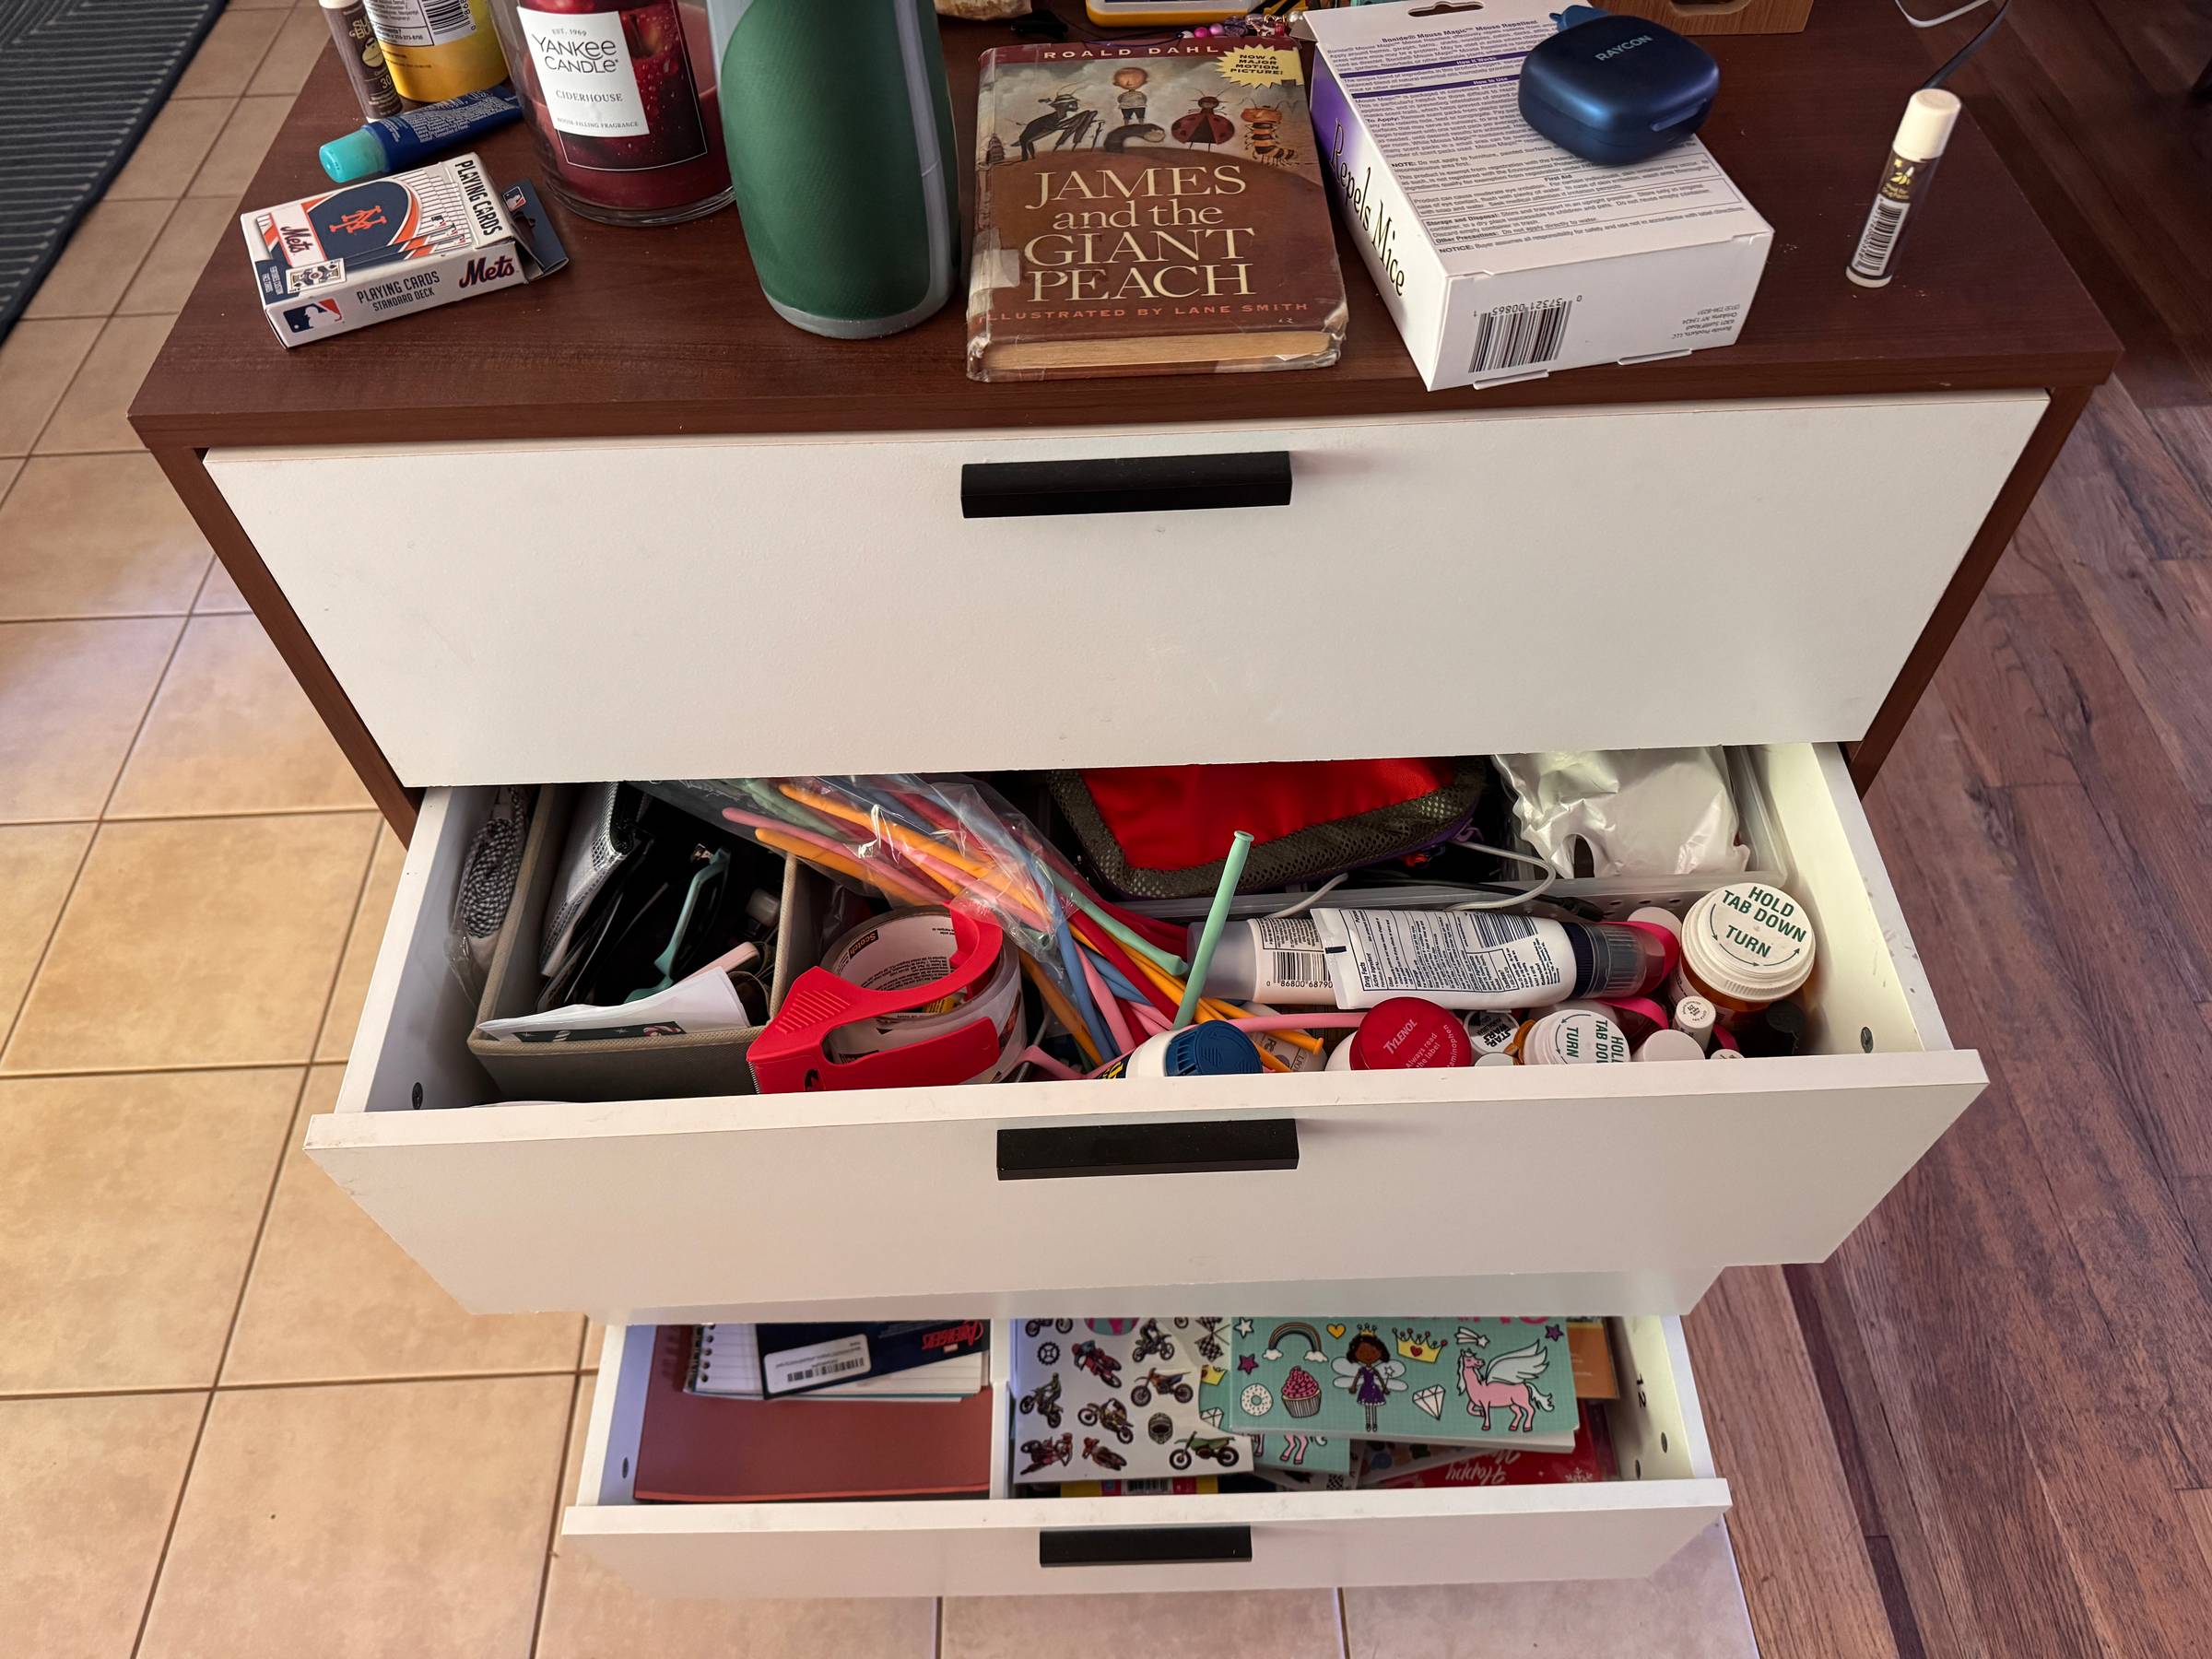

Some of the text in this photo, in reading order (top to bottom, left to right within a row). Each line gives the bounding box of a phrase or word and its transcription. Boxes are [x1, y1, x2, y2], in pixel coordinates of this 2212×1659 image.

[570, 29, 587, 37] 1969
[1043, 44, 1219, 60] ROALD DAHL
[1594, 34, 1653, 63] RAYCON
[381, 75, 392, 88] 30
[1230, 67, 1285, 76] PICTURE!
[556, 89, 623, 103] CIDERHOUSE
[600, 121, 639, 129] FRAGRANCE
[454, 159, 503, 236] PLAYING CARDS
[1025, 165, 1248, 210] JAMES
[1053, 197, 1224, 229] and the
[1331, 118, 1406, 297] Repels Mice
[279, 227, 305, 254] Mets
[1024, 228, 1255, 267] GIANT
[1439, 244, 1475, 253] NOTICE:
[459, 255, 515, 288] Mets
[1027, 263, 1256, 303] PEACH
[357, 270, 441, 304] PLAYING CARDS
[372, 287, 435, 312] STANDARD DECK
[977, 302, 1309, 324] ILLUSTRATED BY LANE SMITH
[1492, 303, 1525, 315] 00865
[1747, 886, 1795, 918] HOLD
[1722, 890, 1807, 943] TAB DOWN
[849, 933, 876, 955] Scotch
[1725, 924, 1772, 959] TURN
[1382, 1018, 1418, 1054] TYLENOL
[1483, 1023, 1509, 1042] WARS
[1484, 1028, 1512, 1047] STAR
[1566, 1027, 1579, 1058] TURN
[1595, 1019, 1608, 1063] TAB DO
[1406, 1032, 1438, 1068] Always read
[1425, 1042, 1441, 1059] label
[1445, 1461, 1508, 1486] Happy
